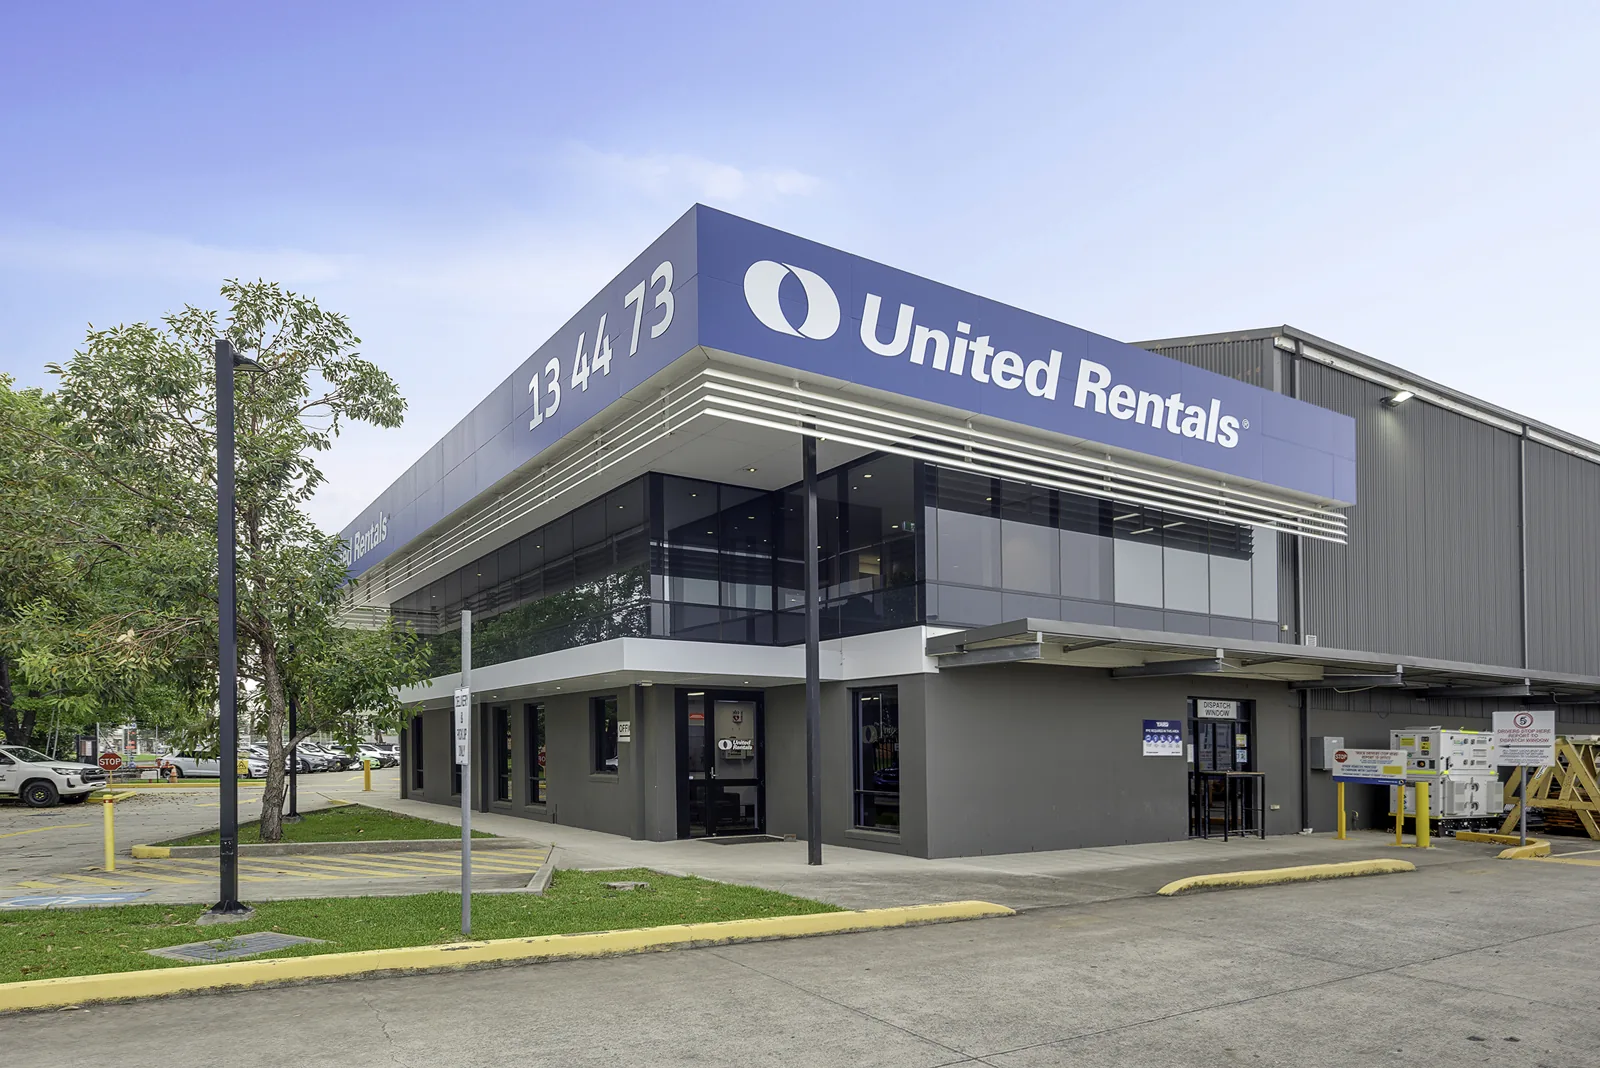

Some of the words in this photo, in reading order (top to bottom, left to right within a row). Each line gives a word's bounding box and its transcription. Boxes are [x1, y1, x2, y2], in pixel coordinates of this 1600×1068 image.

[529, 357, 562, 432] 13
[571, 313, 613, 392] 44
[624, 261, 676, 357] 73
[859, 293, 1062, 399] United
[1203, 701, 1231, 709] DISPATCH
[1205, 709, 1230, 717] WINDOW
[1519, 715, 1527, 725] 5
[100, 758, 121, 766] STOP
